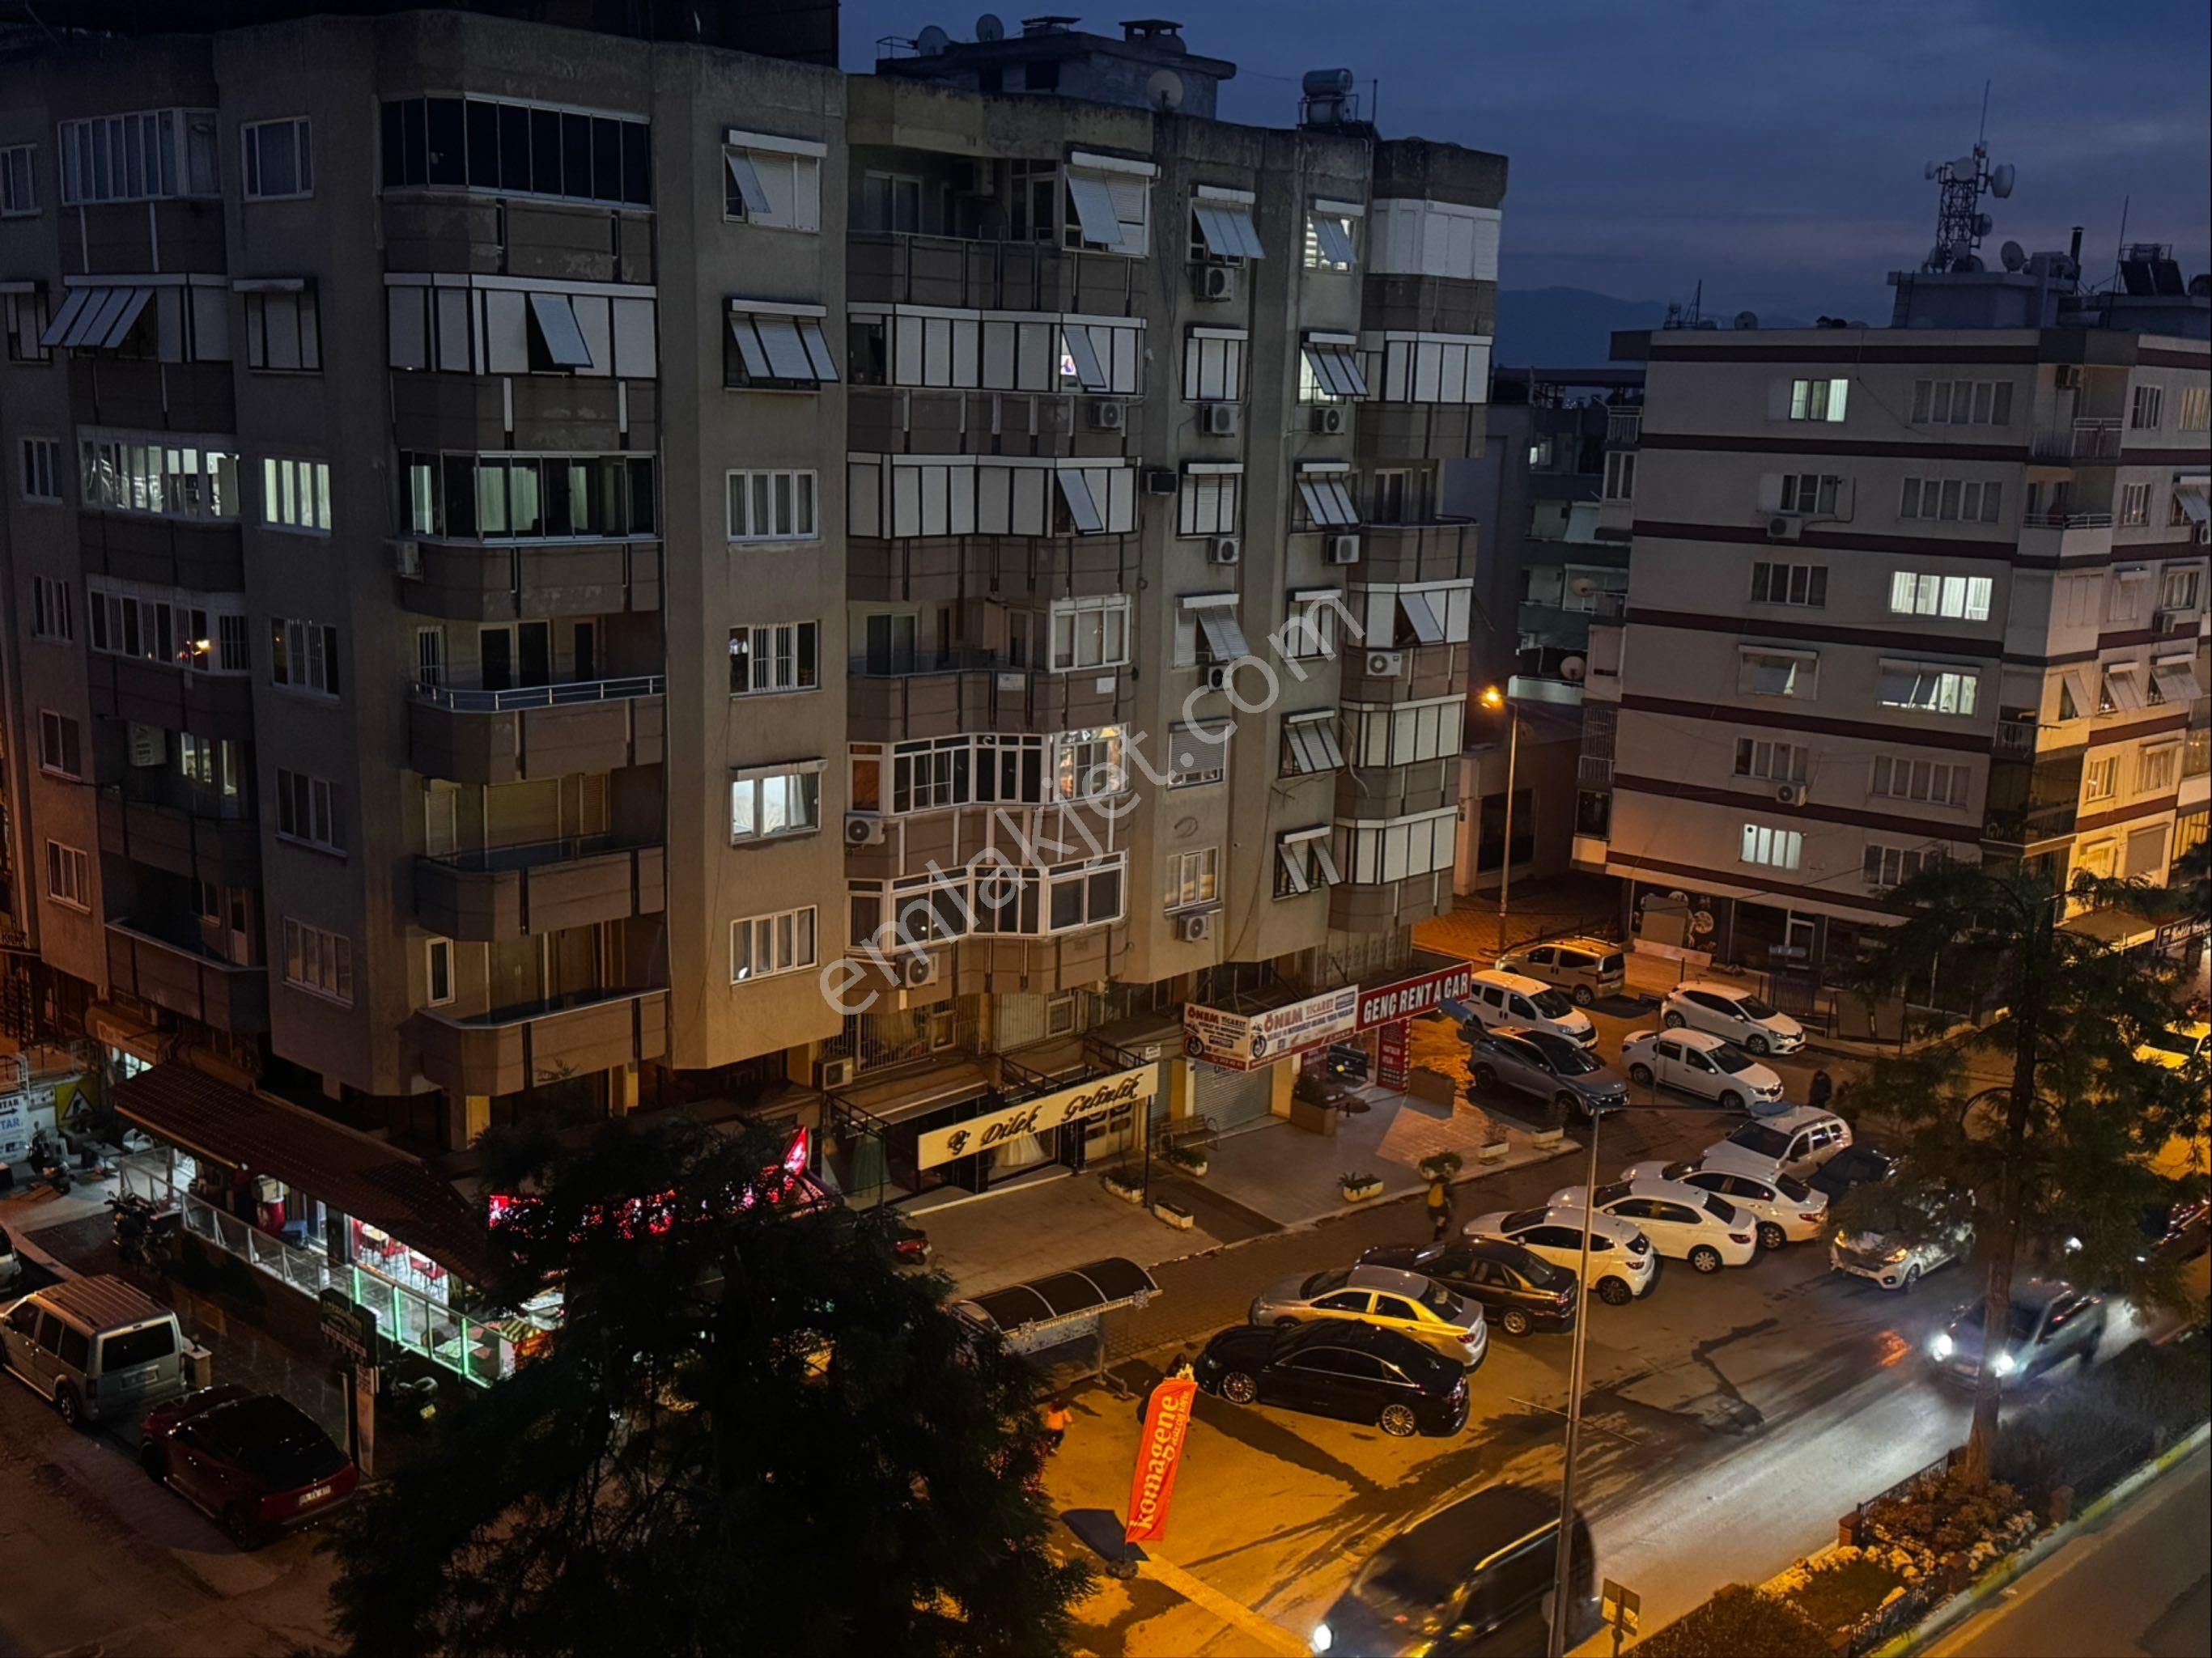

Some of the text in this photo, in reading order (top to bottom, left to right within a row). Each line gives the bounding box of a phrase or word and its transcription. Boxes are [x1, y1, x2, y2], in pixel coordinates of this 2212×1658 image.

[1187, 1007, 1219, 1024] ÖNEM
[1264, 1007, 1303, 1033] ÖNEM
[1363, 992, 1398, 1023] GENÇ
[1399, 983, 1433, 1013] RENT
[1433, 980, 1441, 1003] A
[1444, 972, 1469, 998] CAR
[980, 1105, 1042, 1146] Dilek
[1061, 1073, 1144, 1122] Gelinlik
[1130, 1395, 1178, 1529] komagene
